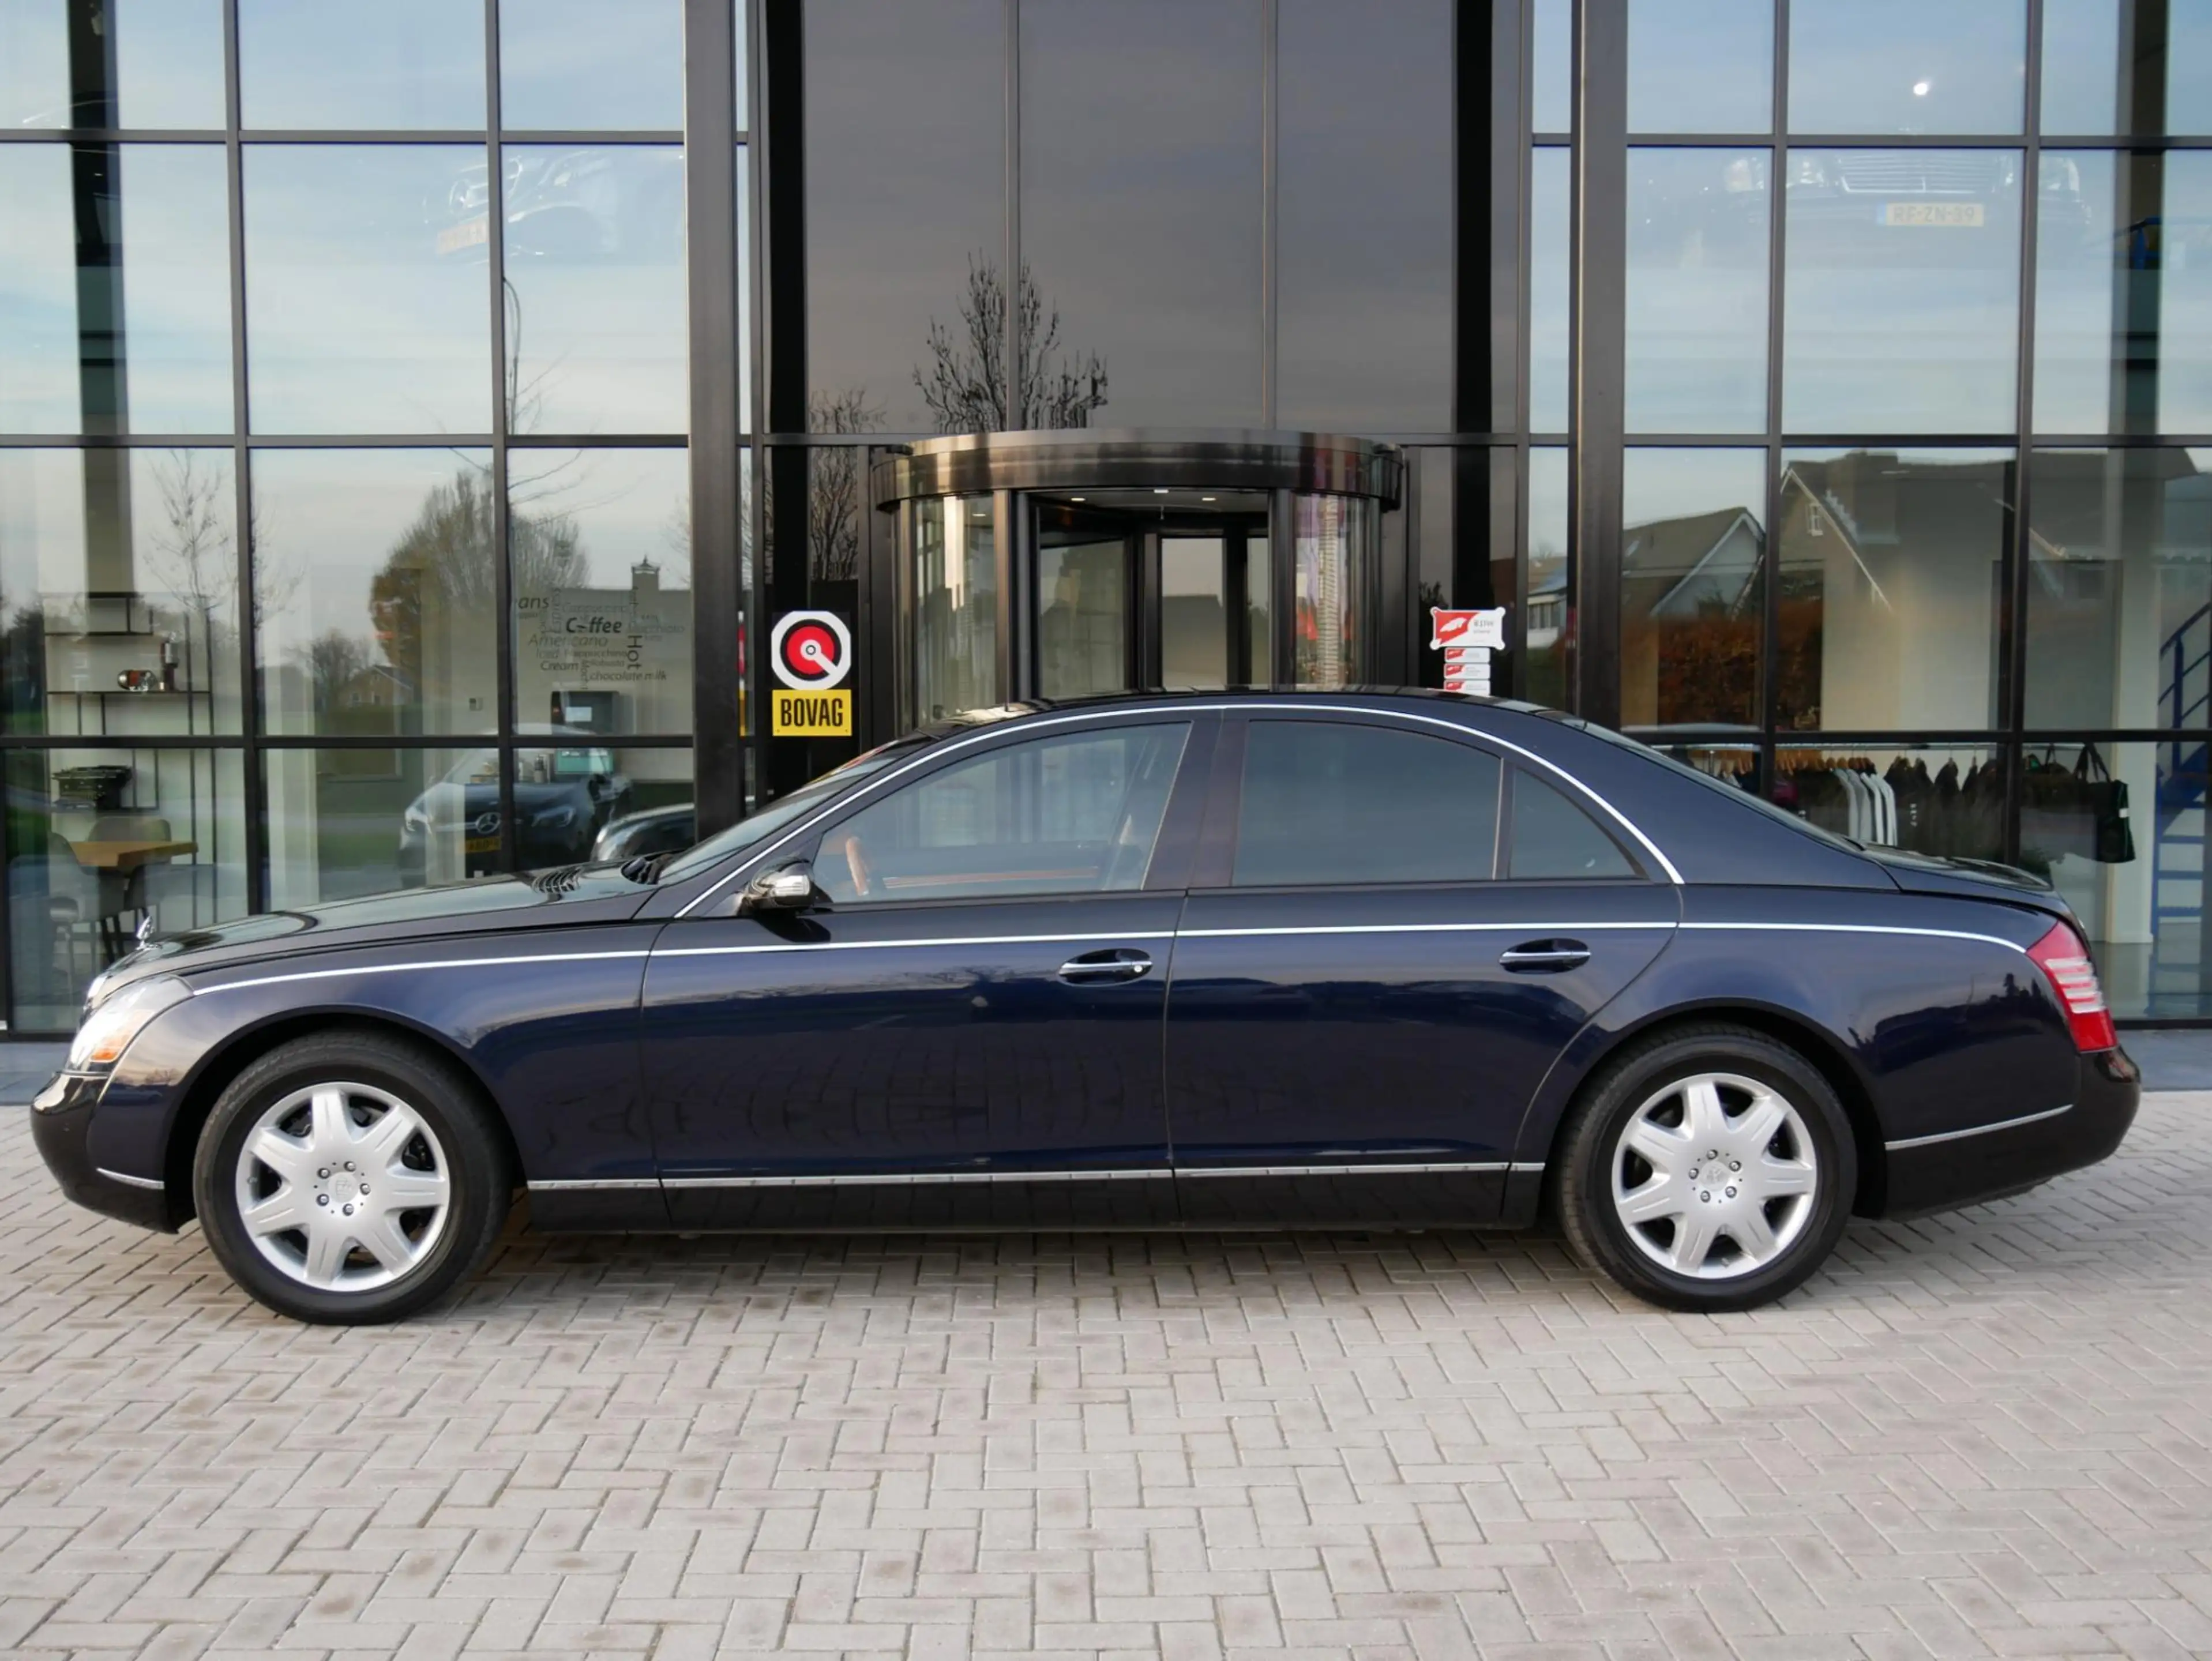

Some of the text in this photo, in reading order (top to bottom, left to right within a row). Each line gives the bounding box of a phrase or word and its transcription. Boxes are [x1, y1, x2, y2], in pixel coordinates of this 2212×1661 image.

[566, 617, 622, 633] Cffee
[628, 636, 643, 670] Hot
[780, 698, 843, 727] BOVAG
